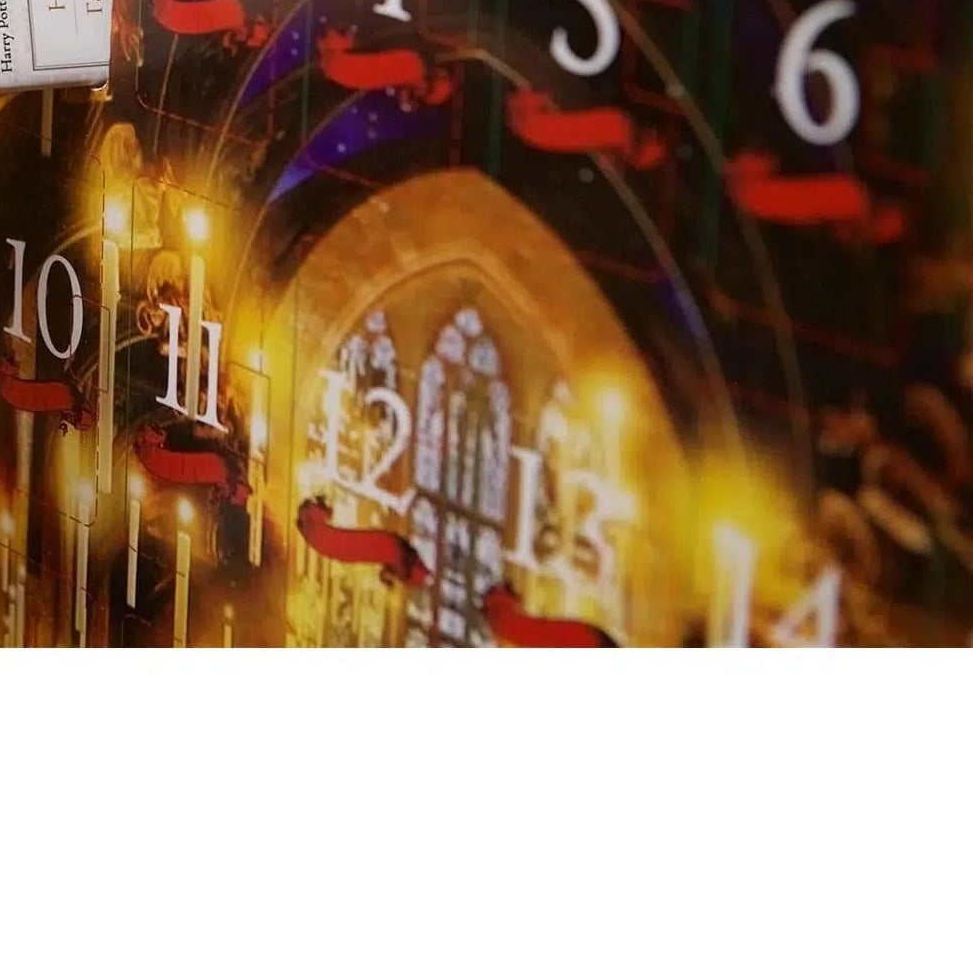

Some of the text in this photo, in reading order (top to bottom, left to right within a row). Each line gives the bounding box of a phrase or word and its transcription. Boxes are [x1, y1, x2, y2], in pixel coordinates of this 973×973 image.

[1, 32, 15, 73] Harry
[2, 237, 84, 360] 10
[155, 302, 230, 433] 11
[318, 367, 416, 515] 12
[502, 445, 629, 592] 13
